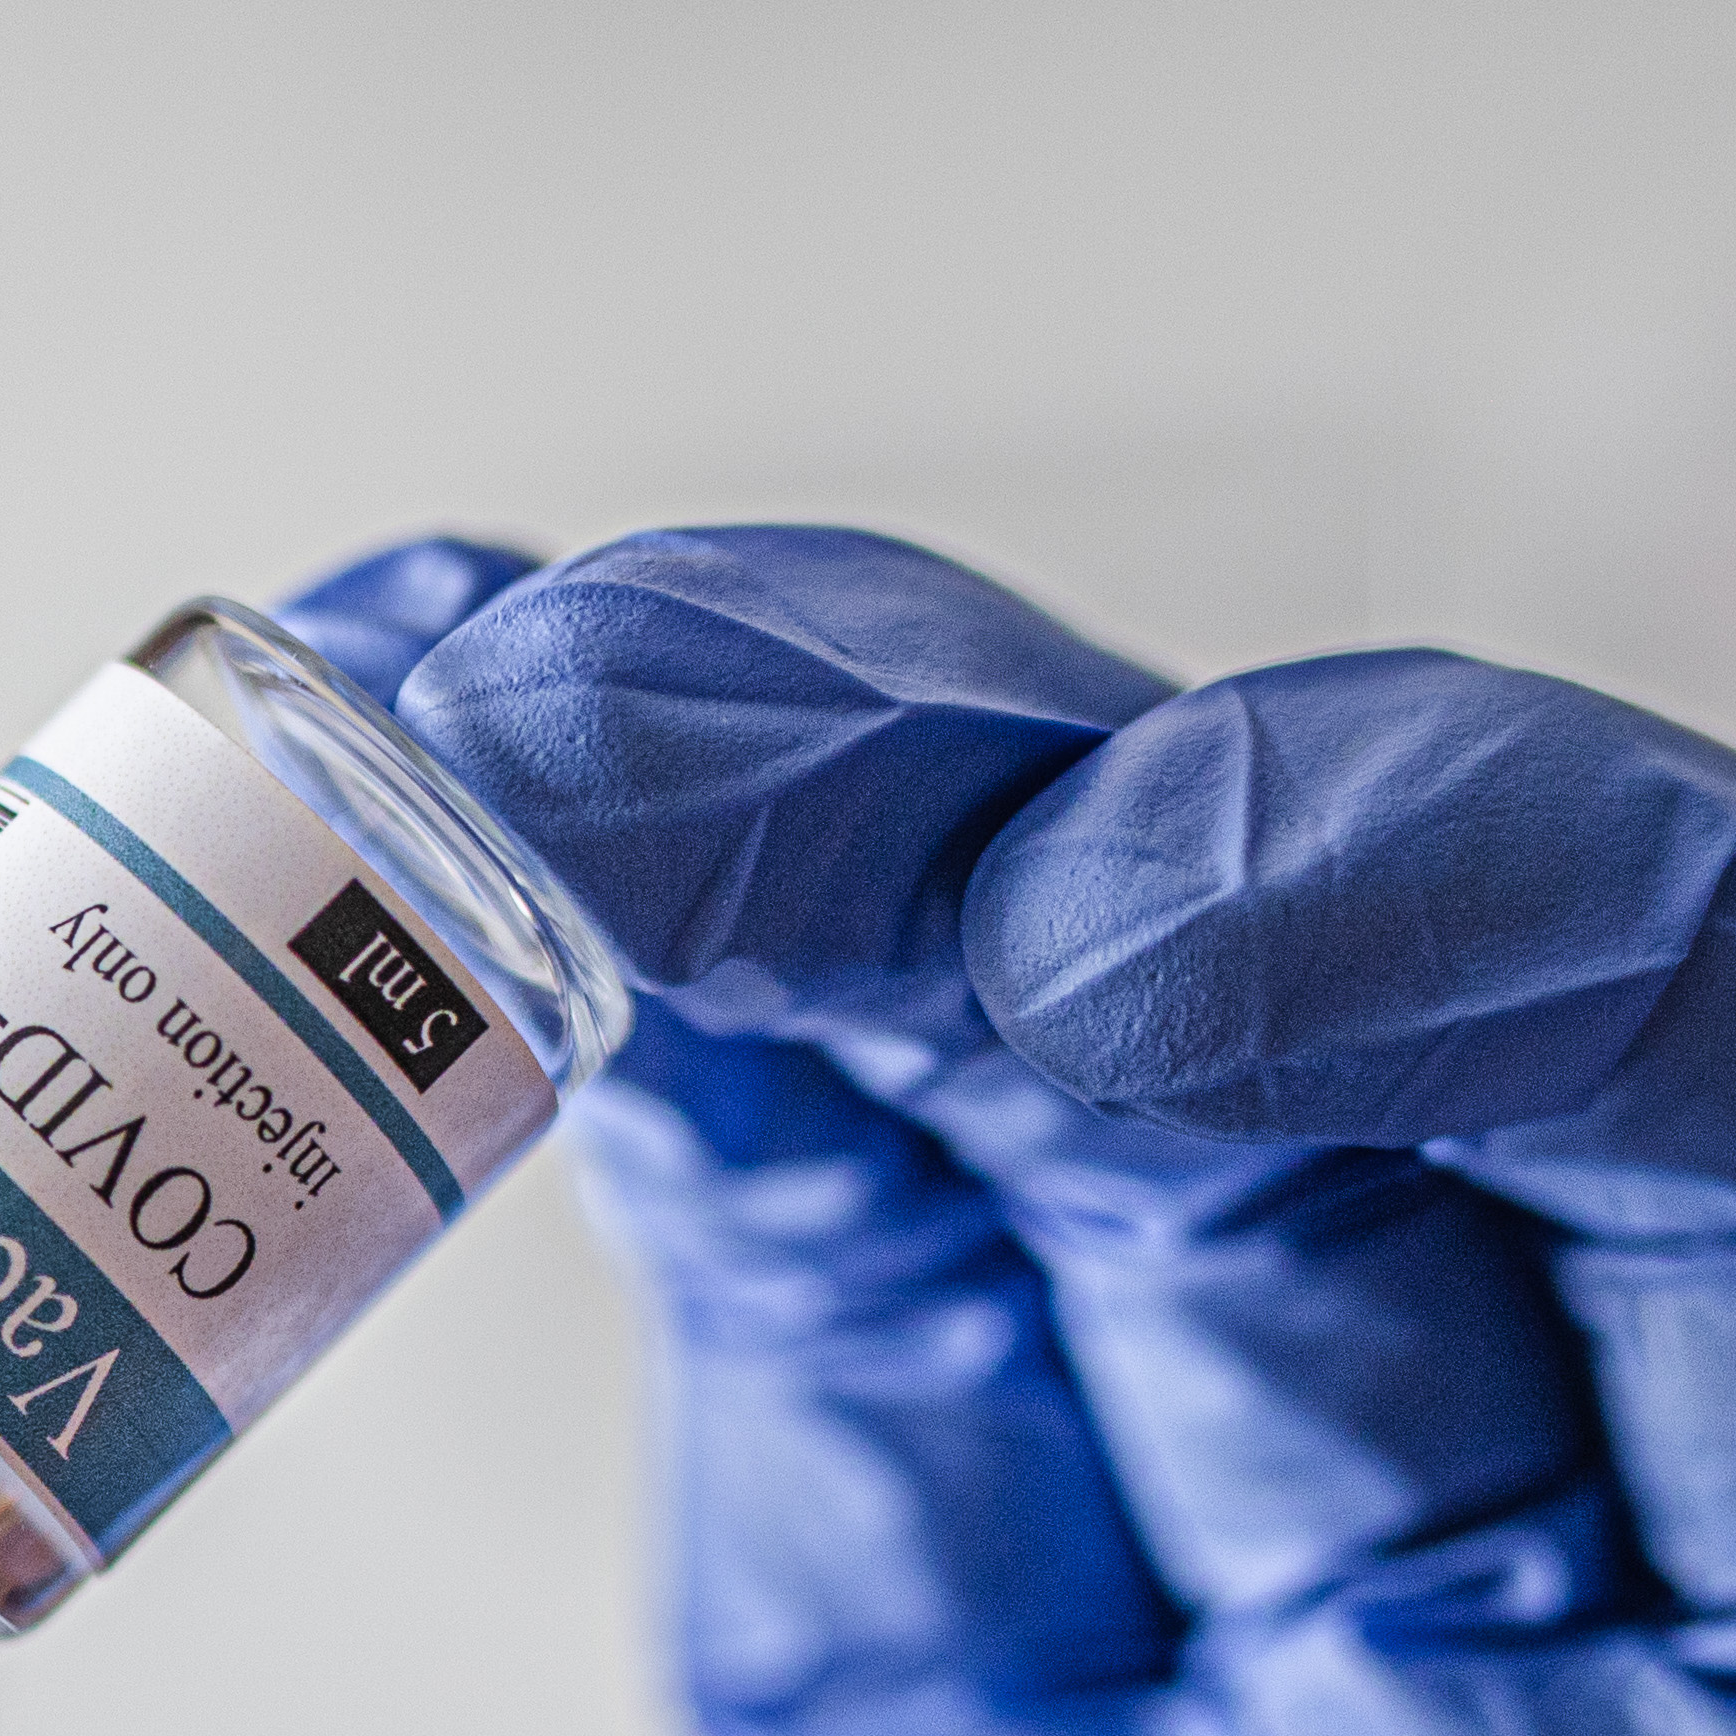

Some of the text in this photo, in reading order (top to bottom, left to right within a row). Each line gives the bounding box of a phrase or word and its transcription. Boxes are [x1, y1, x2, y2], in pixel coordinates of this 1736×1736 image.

[49, 903, 342, 1211] injection only
[338, 930, 459, 1055] 5 ml
